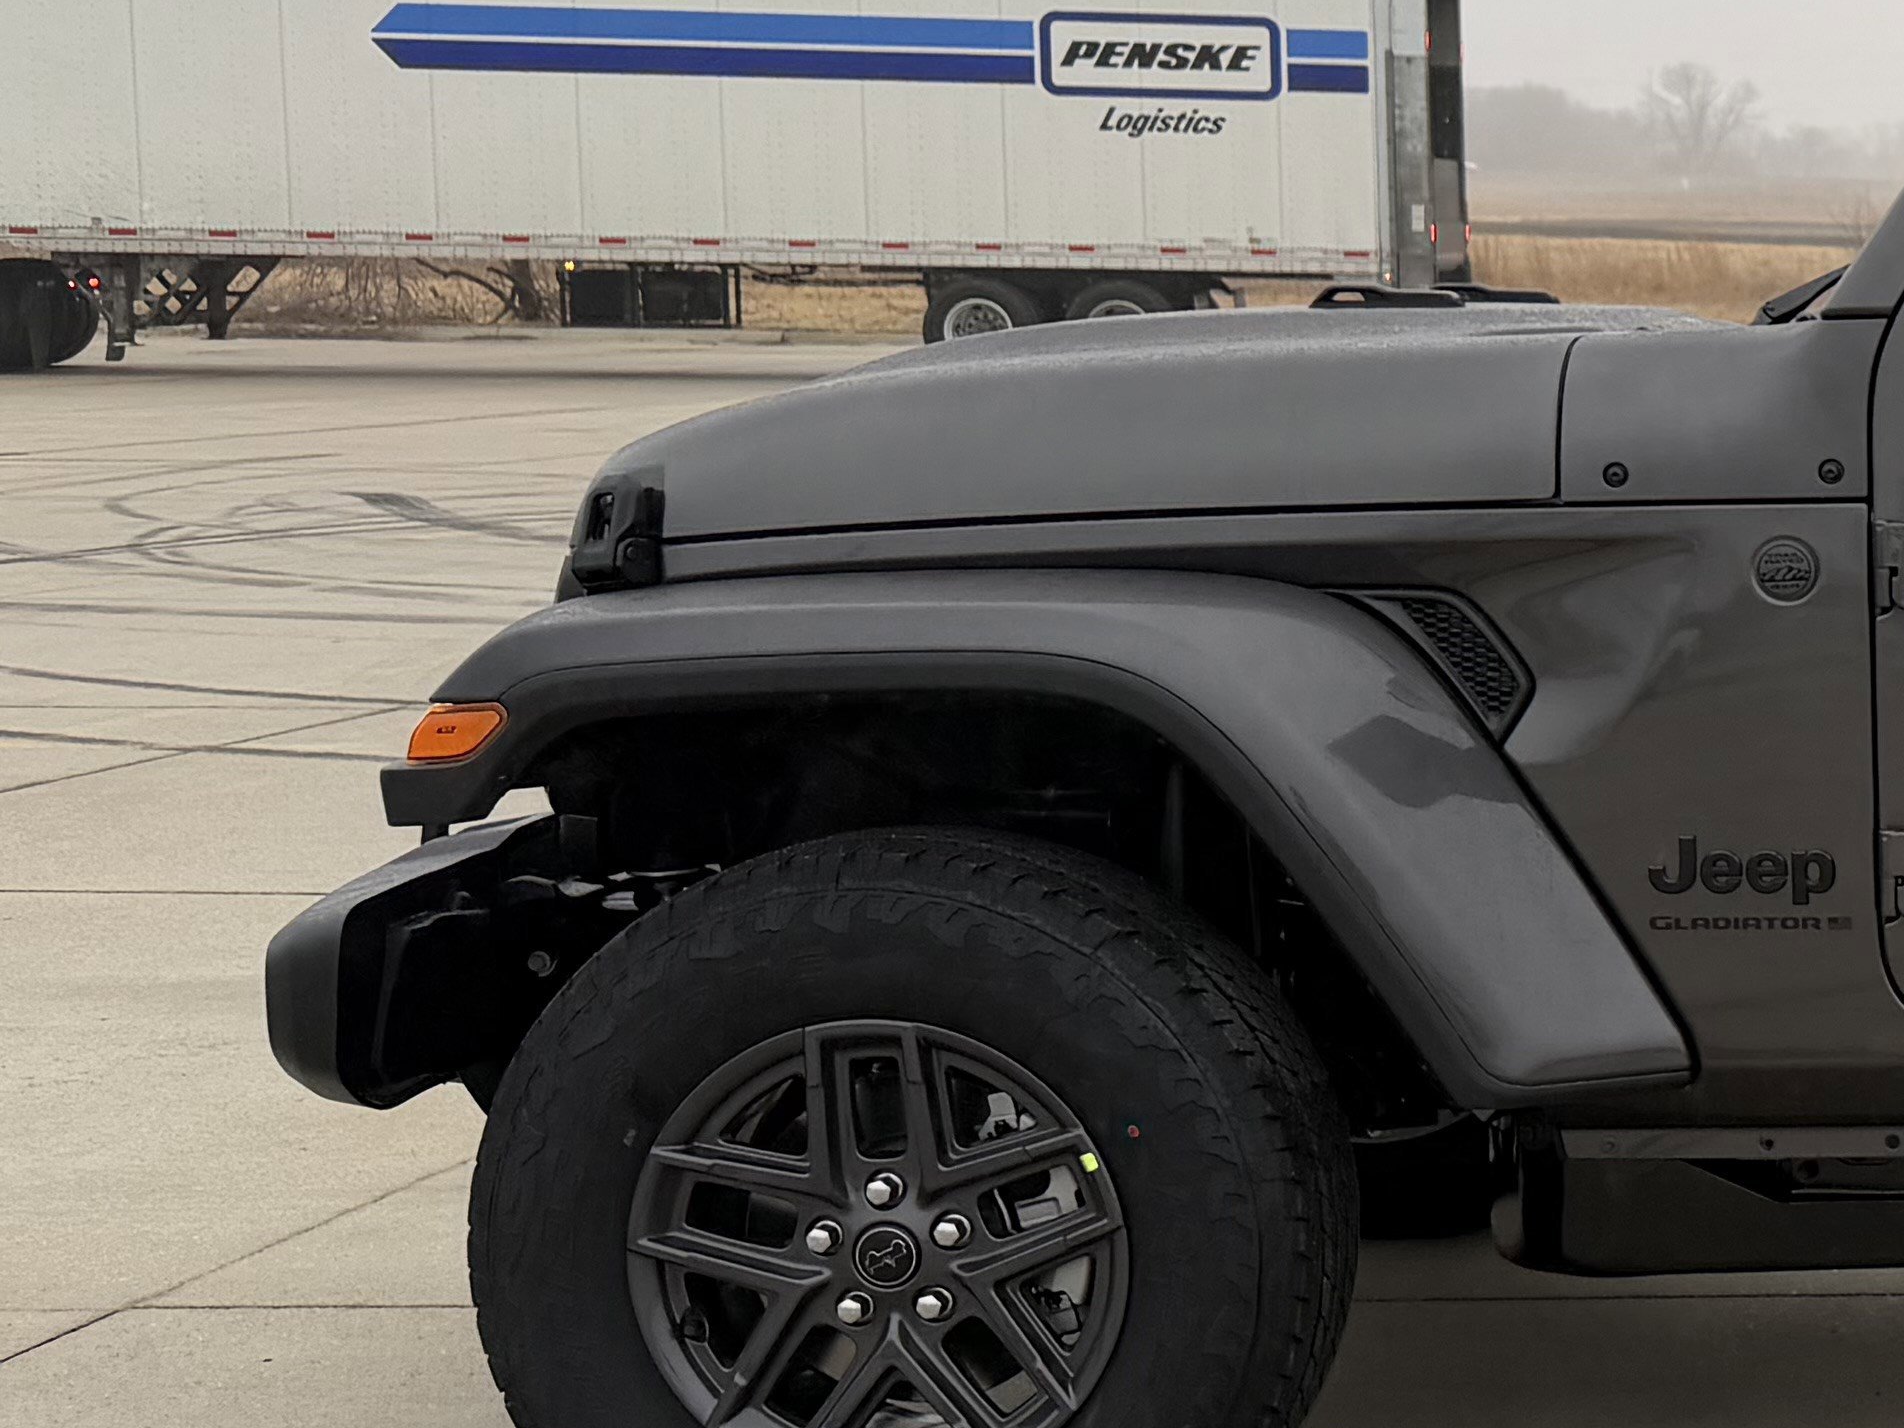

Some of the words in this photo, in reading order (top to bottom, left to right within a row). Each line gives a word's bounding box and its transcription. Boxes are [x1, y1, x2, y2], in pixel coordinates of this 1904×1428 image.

[1060, 40, 1262, 73] PENSKE
[1099, 106, 1227, 138] Logistics
[1648, 835, 1837, 906] Jeep
[1649, 915, 1822, 931] GLADIATOR
